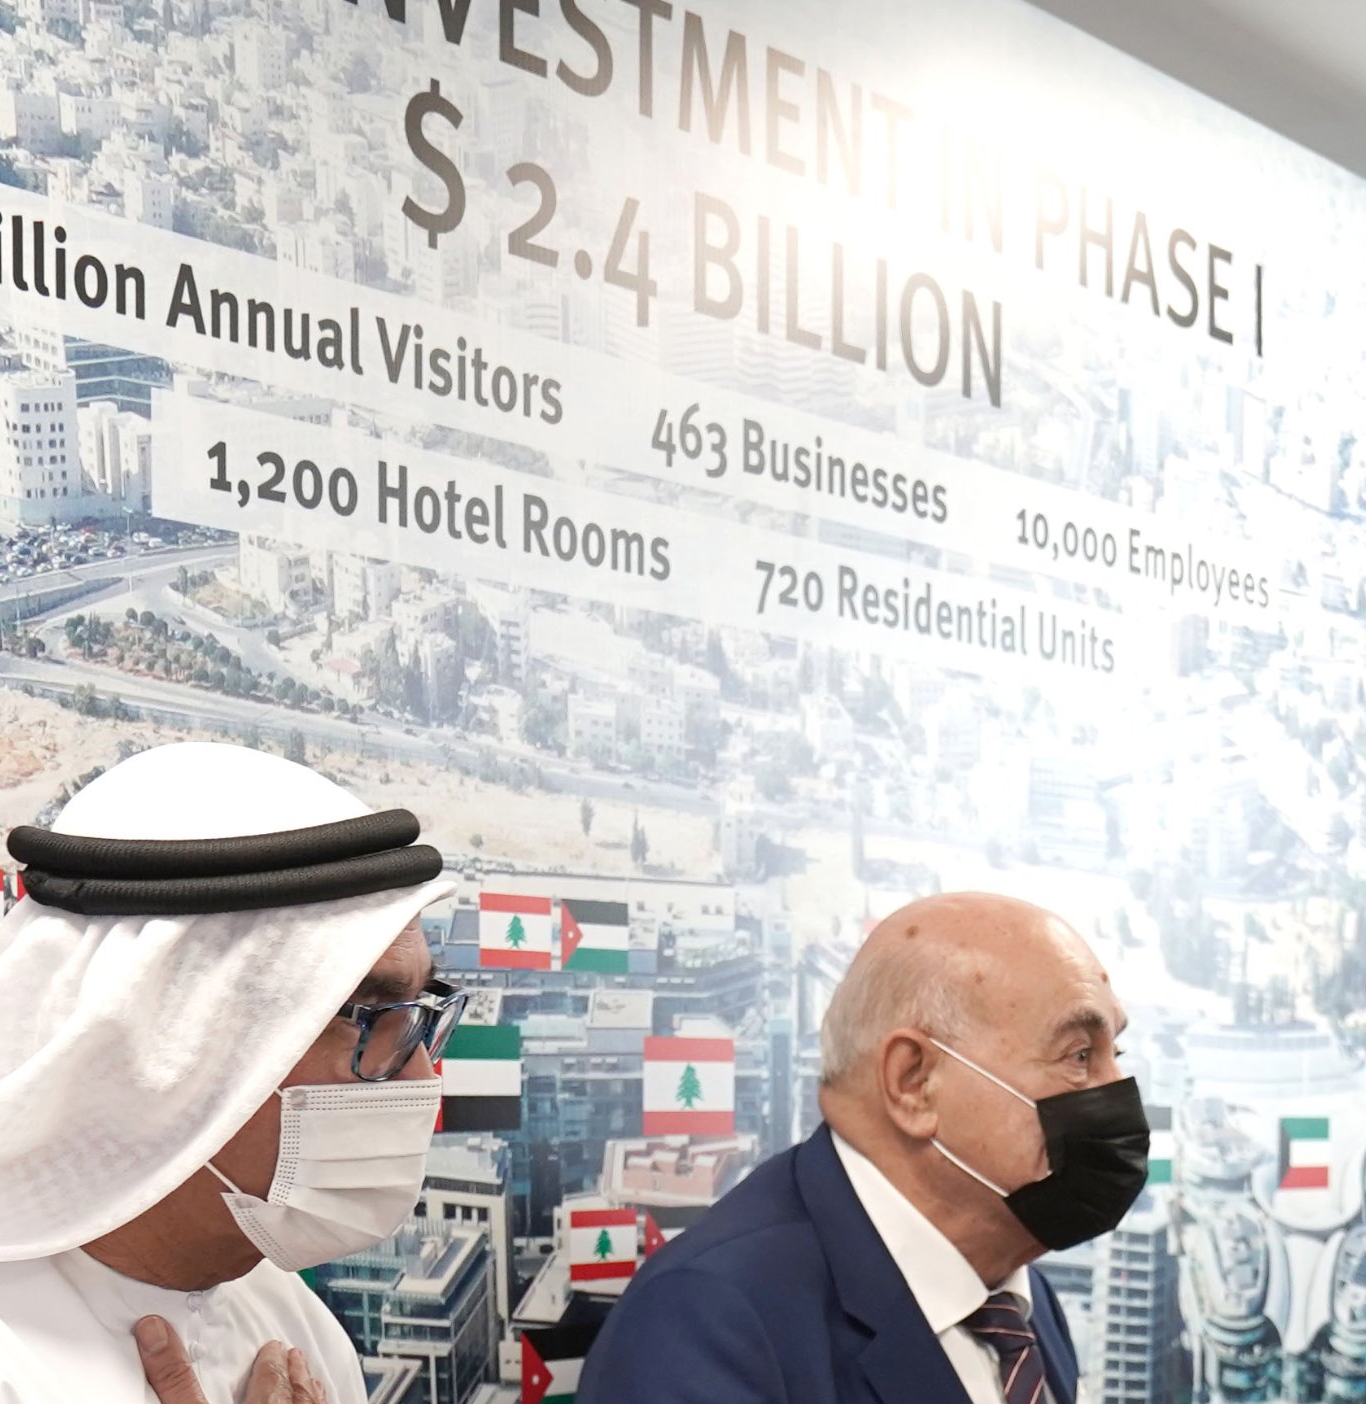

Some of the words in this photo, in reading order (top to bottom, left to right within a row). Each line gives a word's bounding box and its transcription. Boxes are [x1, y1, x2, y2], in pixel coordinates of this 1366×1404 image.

[341, 0, 914, 212] ESTMENT
[941, 122, 1003, 256] IN
[1036, 168, 1235, 347] PHASE
[1254, 262, 1265, 359] I
[402, 78, 466, 250] $
[506, 161, 658, 328] 2.4
[692, 190, 1003, 410] BILLION
[166, 263, 363, 376] Annual
[376, 316, 563, 426] Visitors
[206, 440, 359, 517] 1,200
[377, 460, 507, 549] Hotel
[522, 493, 671, 582] Rooms
[651, 403, 728, 479] 463
[742, 417, 948, 524] Businesses
[755, 559, 825, 615] 720
[837, 566, 1027, 655] Residential
[1038, 611, 1115, 674] Units
[1016, 508, 1117, 568] 10,000
[1128, 527, 1269, 609] Employees
